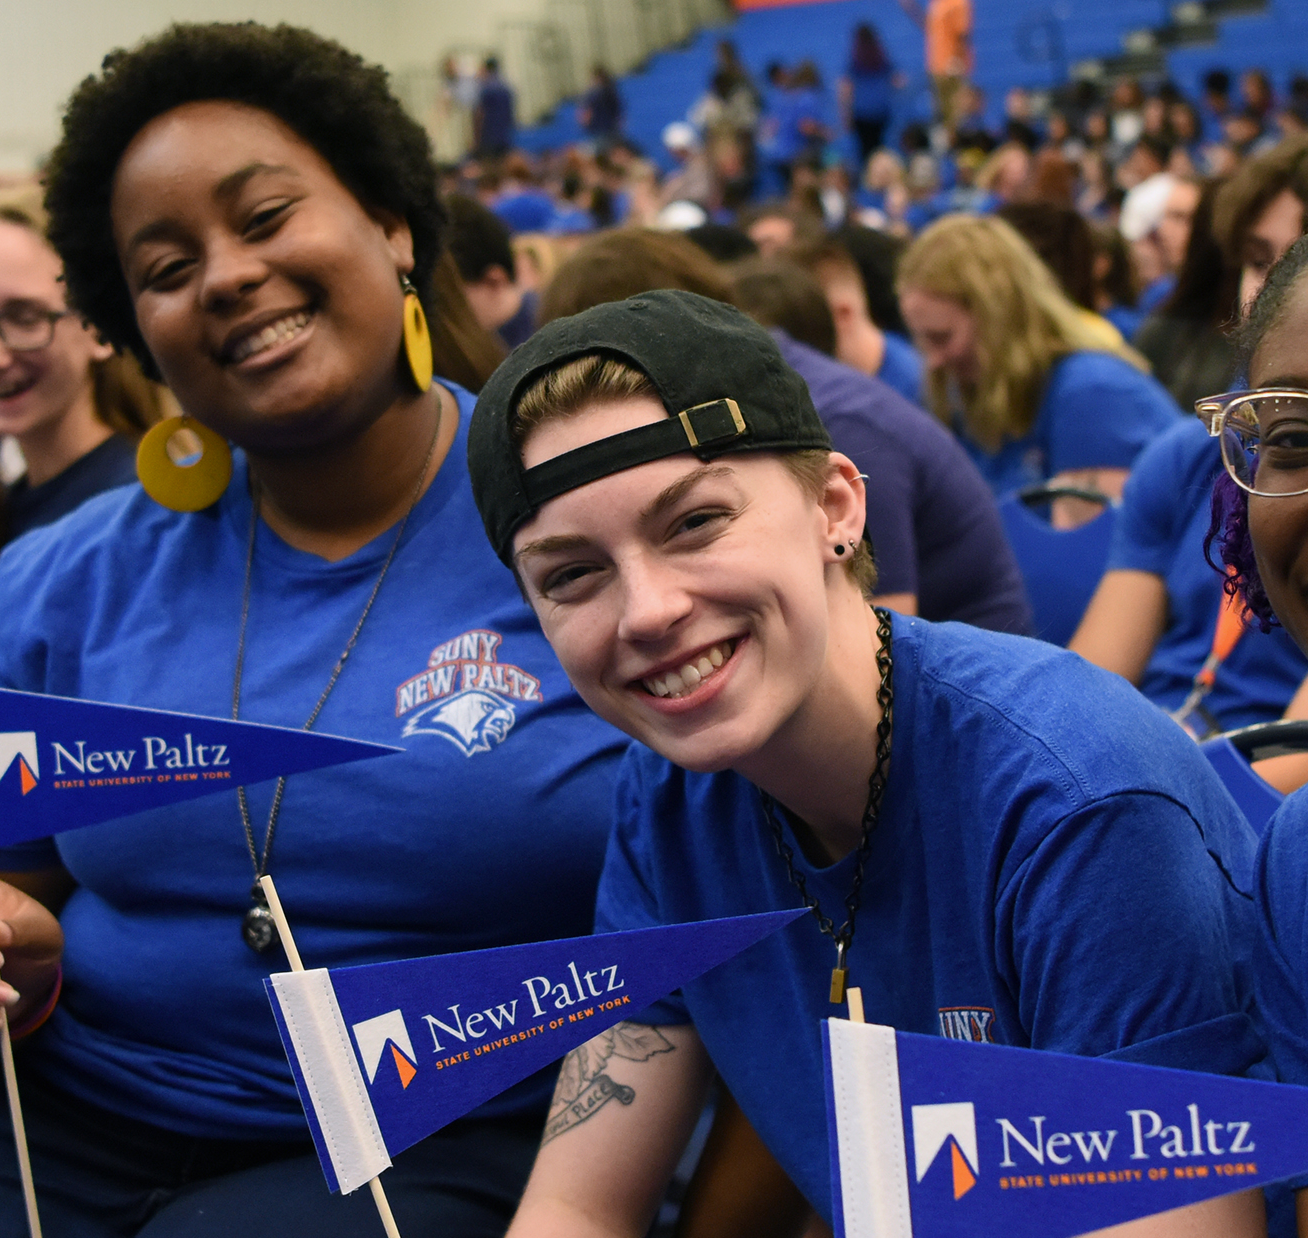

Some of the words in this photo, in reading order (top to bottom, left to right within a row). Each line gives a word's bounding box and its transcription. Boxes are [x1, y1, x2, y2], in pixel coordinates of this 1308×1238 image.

[430, 632, 499, 667] SUNY
[398, 663, 456, 714] NEW
[463, 663, 540, 700] PALTZ
[51, 740, 136, 775] New
[142, 733, 230, 770] Paltz
[53, 779, 85, 789] STATE
[88, 775, 153, 787] UNIVERSITY
[157, 774, 171, 783] OF
[175, 773, 198, 781] NEW
[202, 771, 231, 779] YORK
[421, 999, 519, 1053] New
[521, 961, 625, 1018] Paltz
[938, 1010, 990, 1043] UNY
[435, 1051, 471, 1070] STATE
[474, 1025, 545, 1056] UNIVERSITY
[549, 1018, 565, 1030] OF
[568, 1007, 594, 1023] NEW
[598, 995, 631, 1012] YORK
[995, 1115, 1118, 1167] New
[1126, 1102, 1256, 1159] Paltz
[999, 1175, 1044, 1190] STATE
[1048, 1169, 1142, 1187] UNIVERSITY
[1147, 1167, 1169, 1181] OF
[1174, 1165, 1208, 1179] NEW
[1214, 1162, 1258, 1175] YORK
